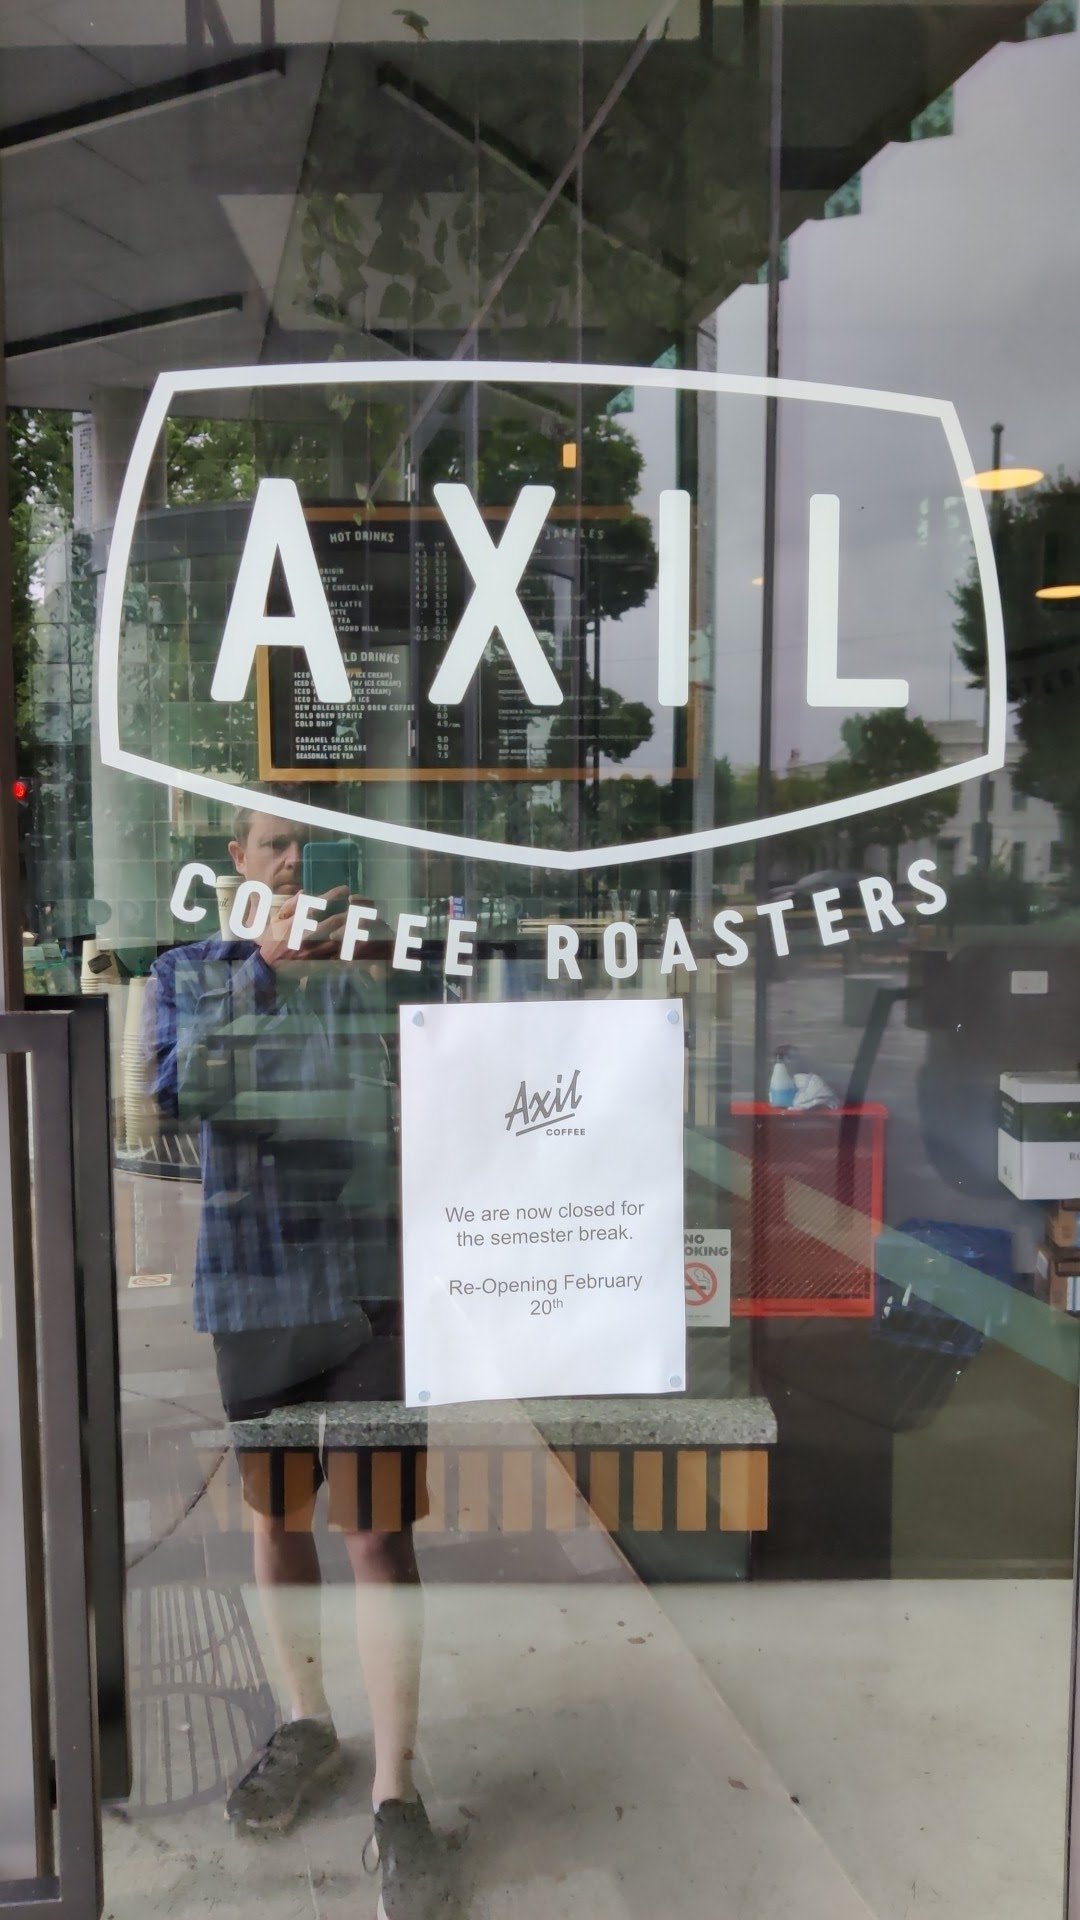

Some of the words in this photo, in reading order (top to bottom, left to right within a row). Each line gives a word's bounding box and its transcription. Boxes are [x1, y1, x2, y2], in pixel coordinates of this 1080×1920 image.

[330, 531, 351, 543] HOT
[355, 531, 395, 543] DRINKS
[211, 479, 909, 707] AXIL
[361, 651, 400, 664] DRINKS
[171, 863, 476, 975] COFFEE
[548, 860, 945, 979] ROASTERS
[504, 1068, 583, 1131] Axil
[545, 1128, 586, 1137] COFFEE
[445, 1206, 475, 1223] We
[481, 1208, 511, 1222] are
[516, 1206, 553, 1220] now
[558, 1200, 615, 1219] closed
[619, 1200, 645, 1217] for
[456, 1229, 485, 1247] the
[490, 1227, 574, 1246] semester
[579, 1223, 634, 1243] break.
[685, 1234, 704, 1245] NO
[685, 1246, 729, 1257] OKING
[449, 1277, 558, 1298] Re-Opening
[563, 1272, 643, 1295] February
[530, 1297, 564, 1317] 20th
